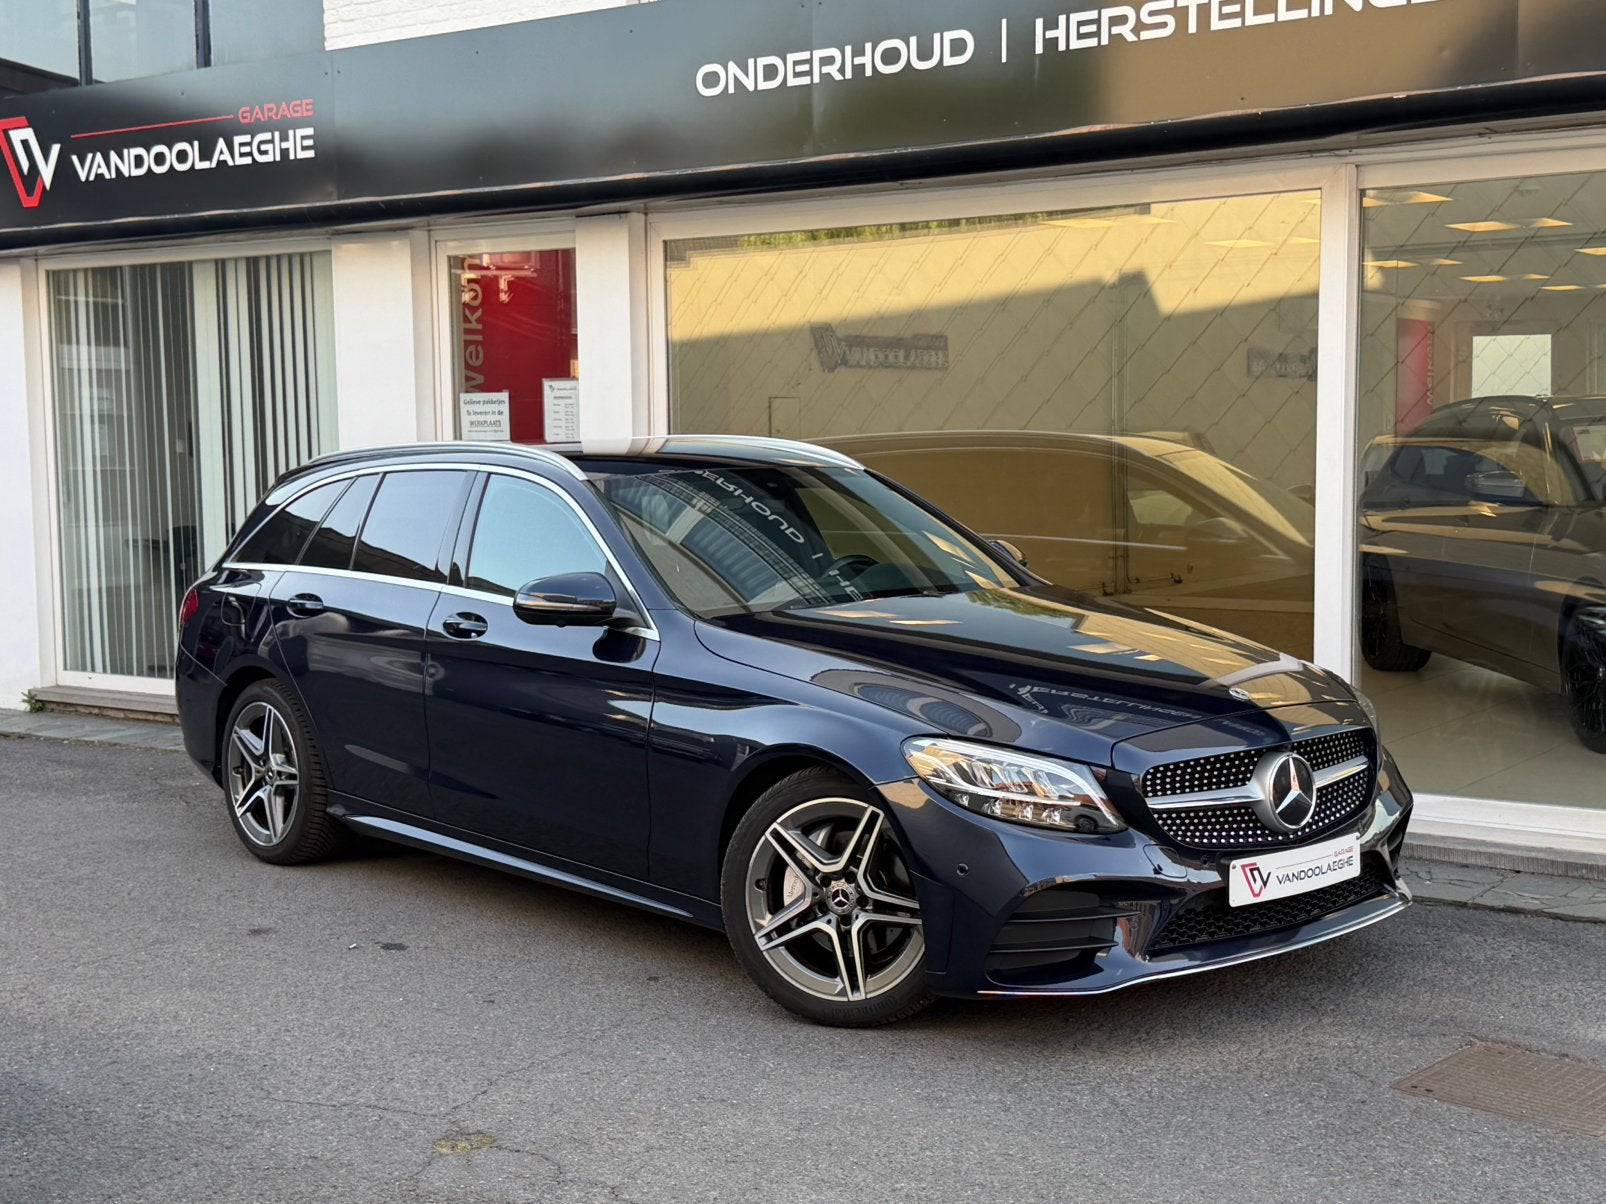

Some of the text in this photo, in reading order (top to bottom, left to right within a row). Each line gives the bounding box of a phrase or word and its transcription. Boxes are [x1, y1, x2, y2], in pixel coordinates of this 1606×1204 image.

[695, 0, 1439, 97] ONDERHOUD HERSTELL
[238, 98, 314, 125] GARAGE
[70, 127, 316, 183] VANDOOLAEGHE
[469, 419, 502, 427] WERKPLAATS
[1333, 845, 1354, 858] GARAGE
[1276, 855, 1354, 885] VANDOOLAEGHE
